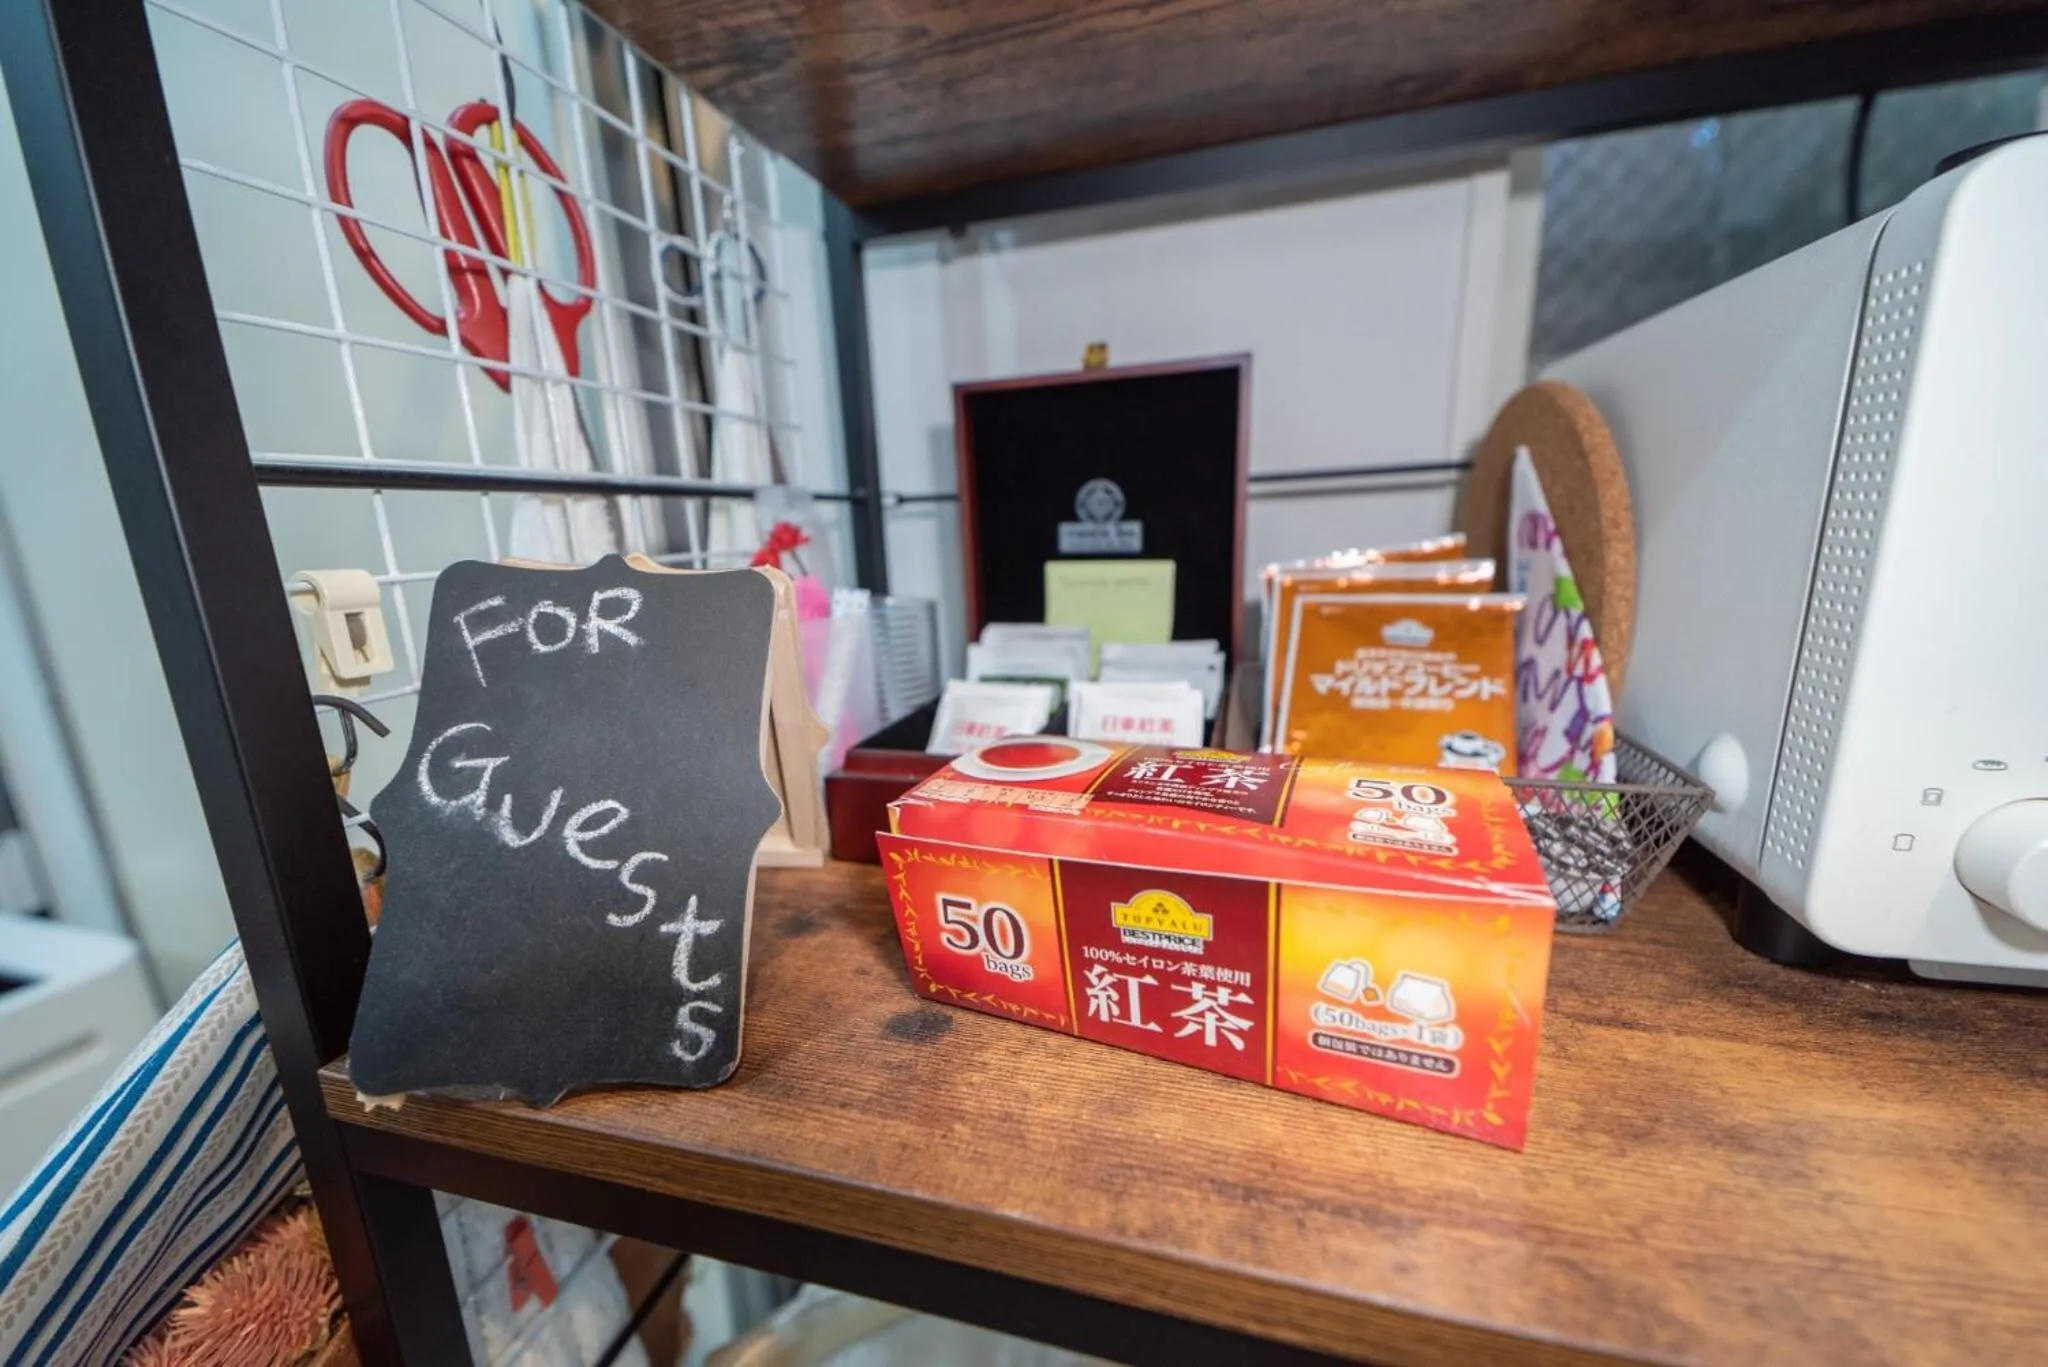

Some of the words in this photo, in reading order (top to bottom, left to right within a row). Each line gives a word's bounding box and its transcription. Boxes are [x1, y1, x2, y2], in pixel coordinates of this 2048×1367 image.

[453, 586, 645, 687] FOR
[1309, 673, 1507, 701] マイルドブレンド
[1123, 762, 1271, 791] 紅茶
[1351, 778, 1448, 806] 50
[416, 722, 724, 1062] Guests
[940, 896, 1027, 961] 50
[1120, 912, 1205, 932] TOPVALU
[984, 953, 1034, 981] bags
[1082, 945, 1252, 988] 100%セイロン茶葉使用
[1083, 963, 1255, 1051] 紅茶
